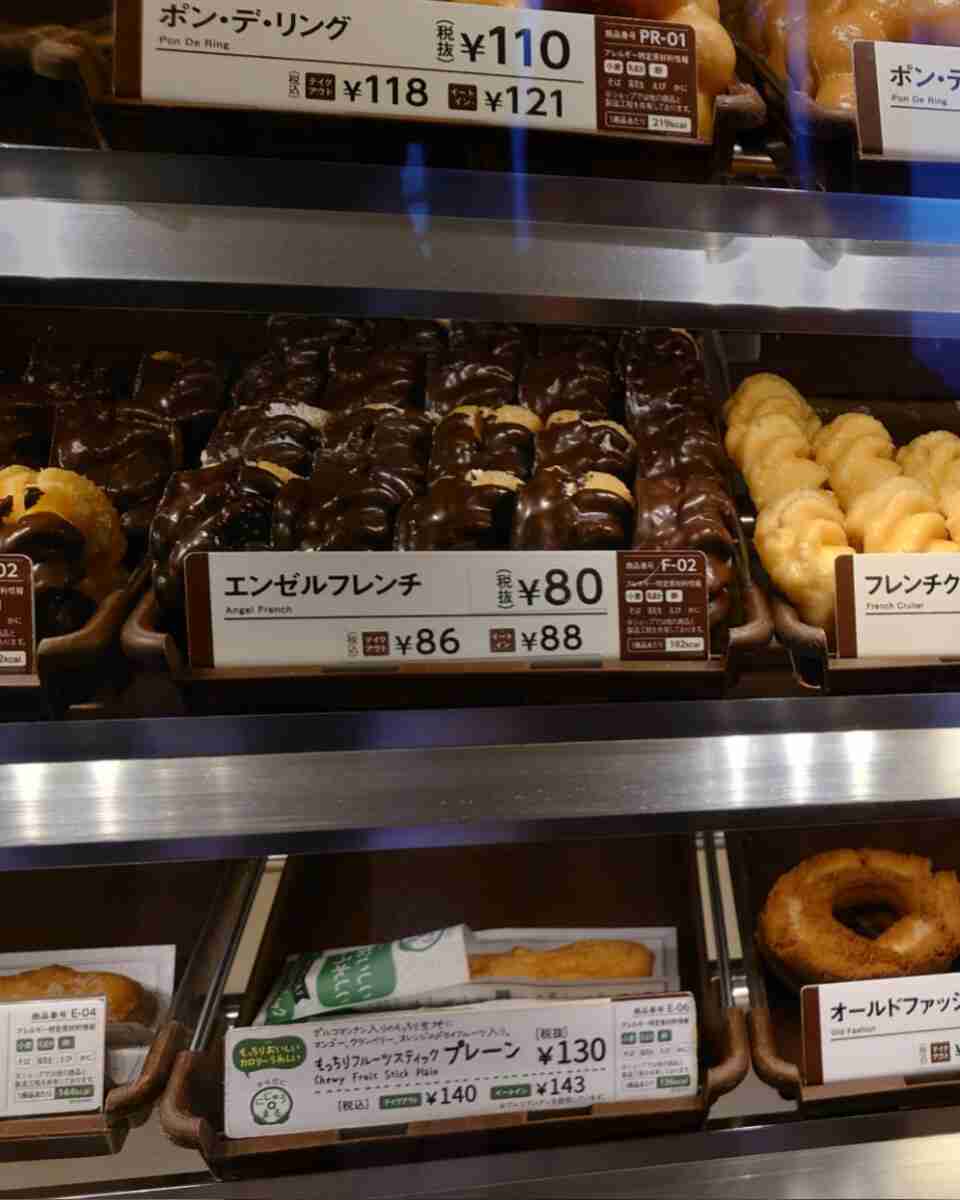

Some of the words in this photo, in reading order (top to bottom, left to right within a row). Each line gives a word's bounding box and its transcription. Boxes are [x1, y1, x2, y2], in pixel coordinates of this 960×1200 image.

[159, 3, 352, 42] ポン・デ・リング
[639, 29, 687, 48] PR-01
[461, 26, 571, 70] ¥110
[345, 75, 429, 107] ¥118
[485, 86, 563, 118] ¥121
[661, 558, 697, 573] F-02
[225, 571, 422, 597] エンゼルフレンチ
[519, 567, 603, 607] ¥80
[395, 627, 460, 656] ¥86
[522, 623, 583, 651] ¥88
[442, 1040, 521, 1067] プレーン
[538, 1036, 607, 1066] ¥130
[425, 1085, 478, 1107] ¥140
[537, 1075, 587, 1097] ¥143
